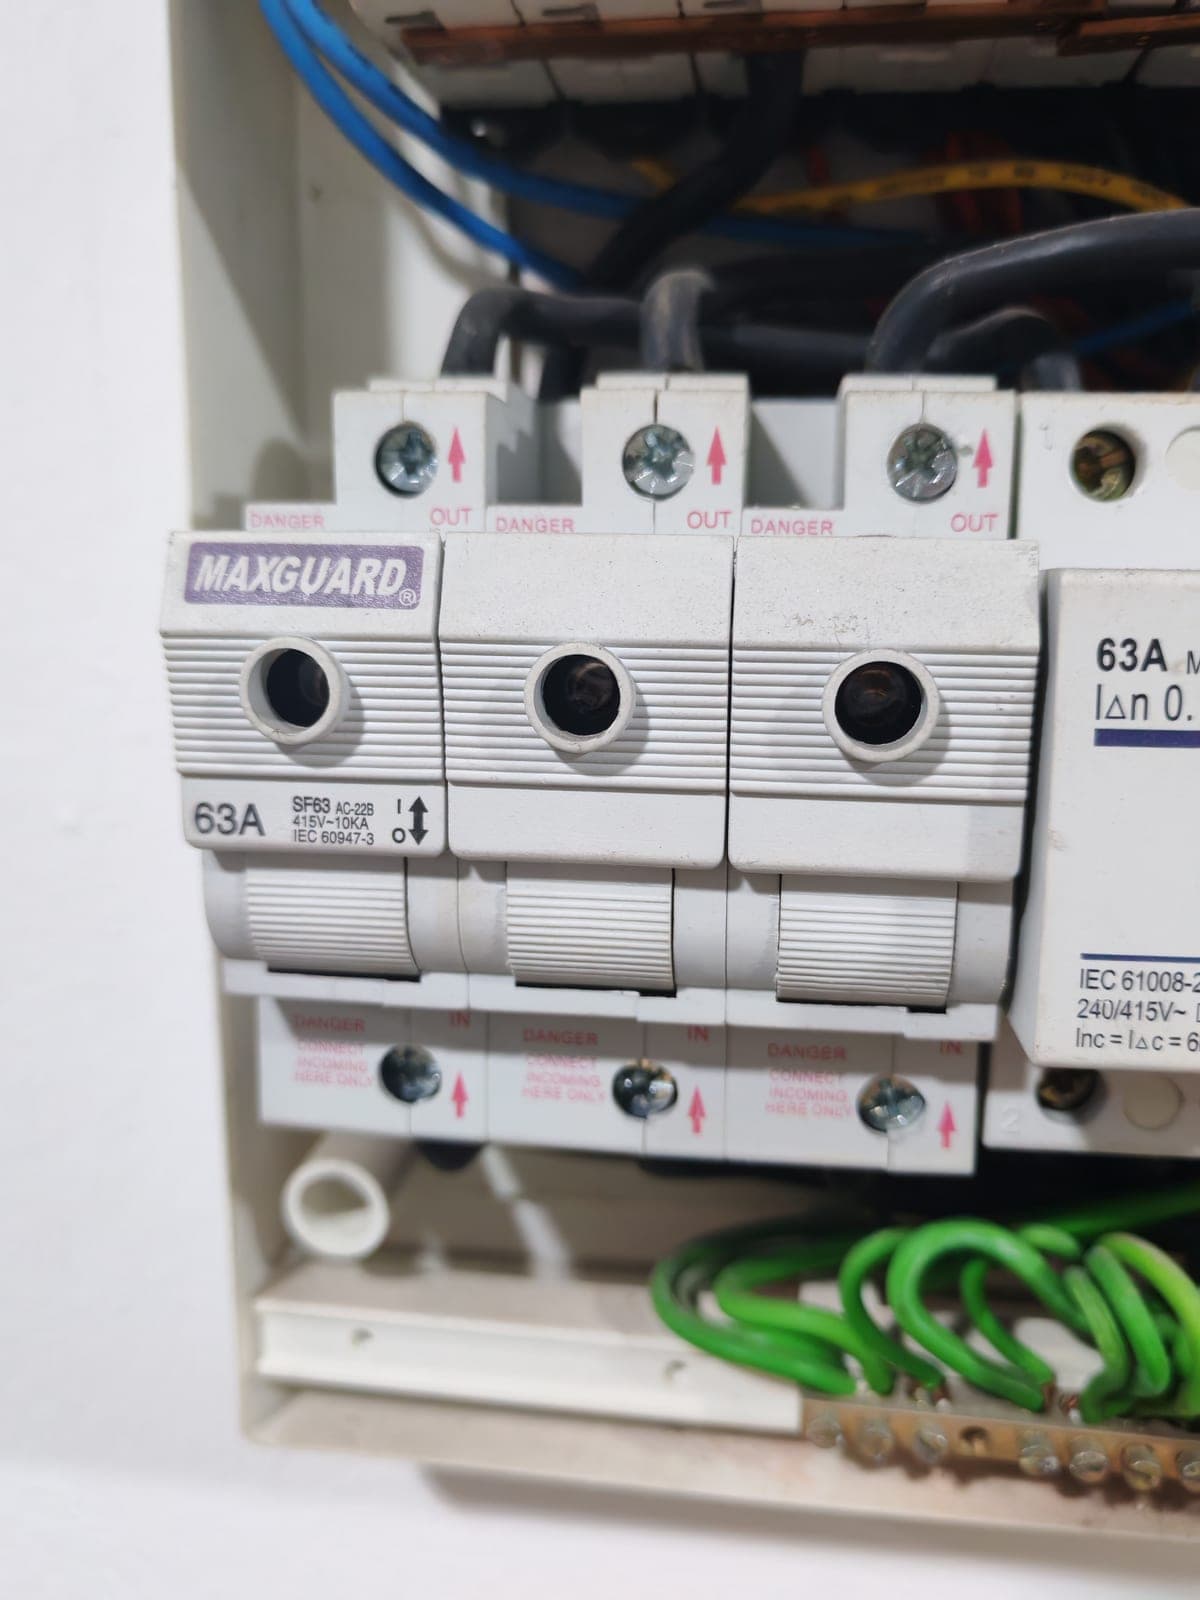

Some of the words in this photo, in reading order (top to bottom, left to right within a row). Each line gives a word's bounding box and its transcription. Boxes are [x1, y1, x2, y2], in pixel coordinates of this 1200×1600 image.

[250, 512, 325, 530] DANGER
[429, 507, 474, 526] OUT
[495, 516, 576, 533] DANGER
[686, 510, 732, 530] OUT
[950, 513, 998, 532] OUT
[751, 518, 834, 535] DANGER
[1096, 637, 1168, 672] 63A
[292, 796, 331, 814] SF63
[335, 801, 375, 816] AC-22B
[194, 801, 266, 837] 63A
[292, 815, 369, 830] 415V~10KA
[293, 829, 318, 843] IEC
[321, 831, 375, 846] 60947-3
[1080, 968, 1116, 991] IEC
[1121, 970, 1200, 993] 61008-2
[1077, 998, 1187, 1022] 240/415V~
[292, 1013, 365, 1033] DANGER
[450, 1012, 471, 1029] IN
[523, 1028, 598, 1046] DANGER
[688, 1025, 709, 1042] IN
[1186, 1031, 1200, 1053] 6
[768, 1042, 846, 1060] DANGER
[939, 1041, 962, 1055] IN
[769, 1069, 845, 1084] CONNECT
[769, 1086, 848, 1102] INCOMING
[765, 1102, 807, 1116] HERE
